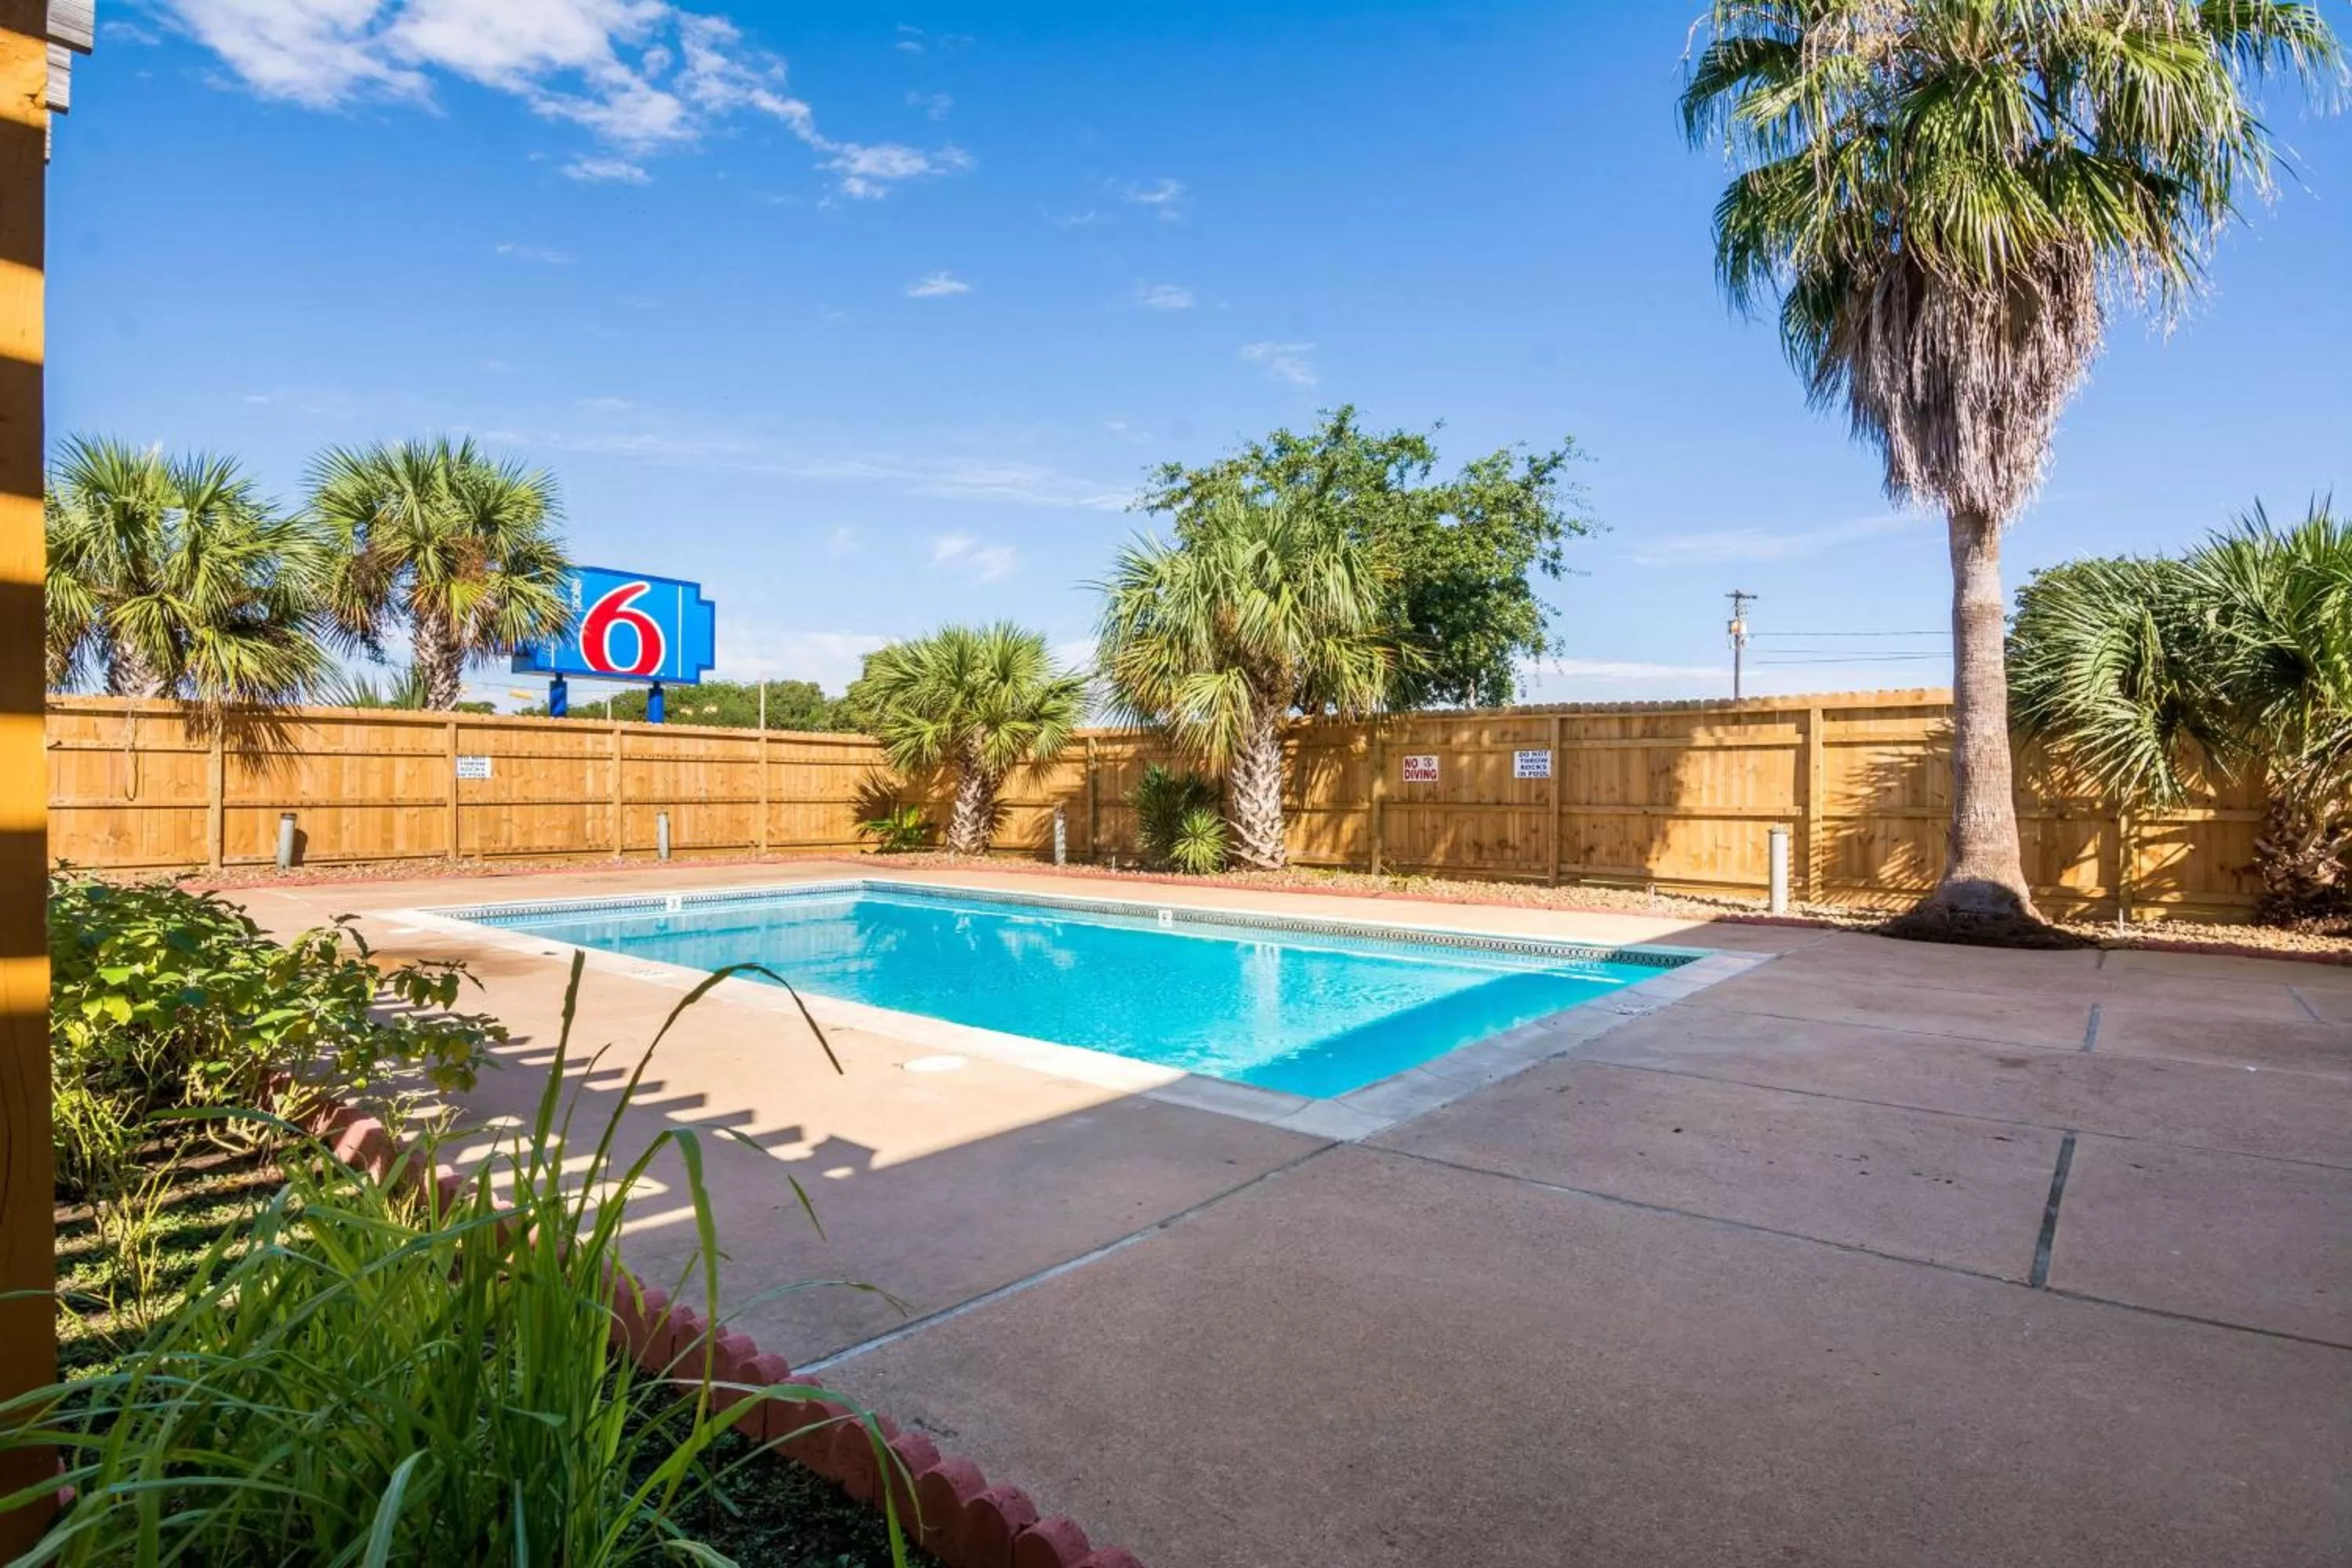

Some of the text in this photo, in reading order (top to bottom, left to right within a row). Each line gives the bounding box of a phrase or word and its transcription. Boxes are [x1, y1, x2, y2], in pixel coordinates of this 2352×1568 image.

[579, 580, 666, 677] 6
[1404, 758, 1418, 768] NO
[1404, 769, 1437, 780] DIVING
